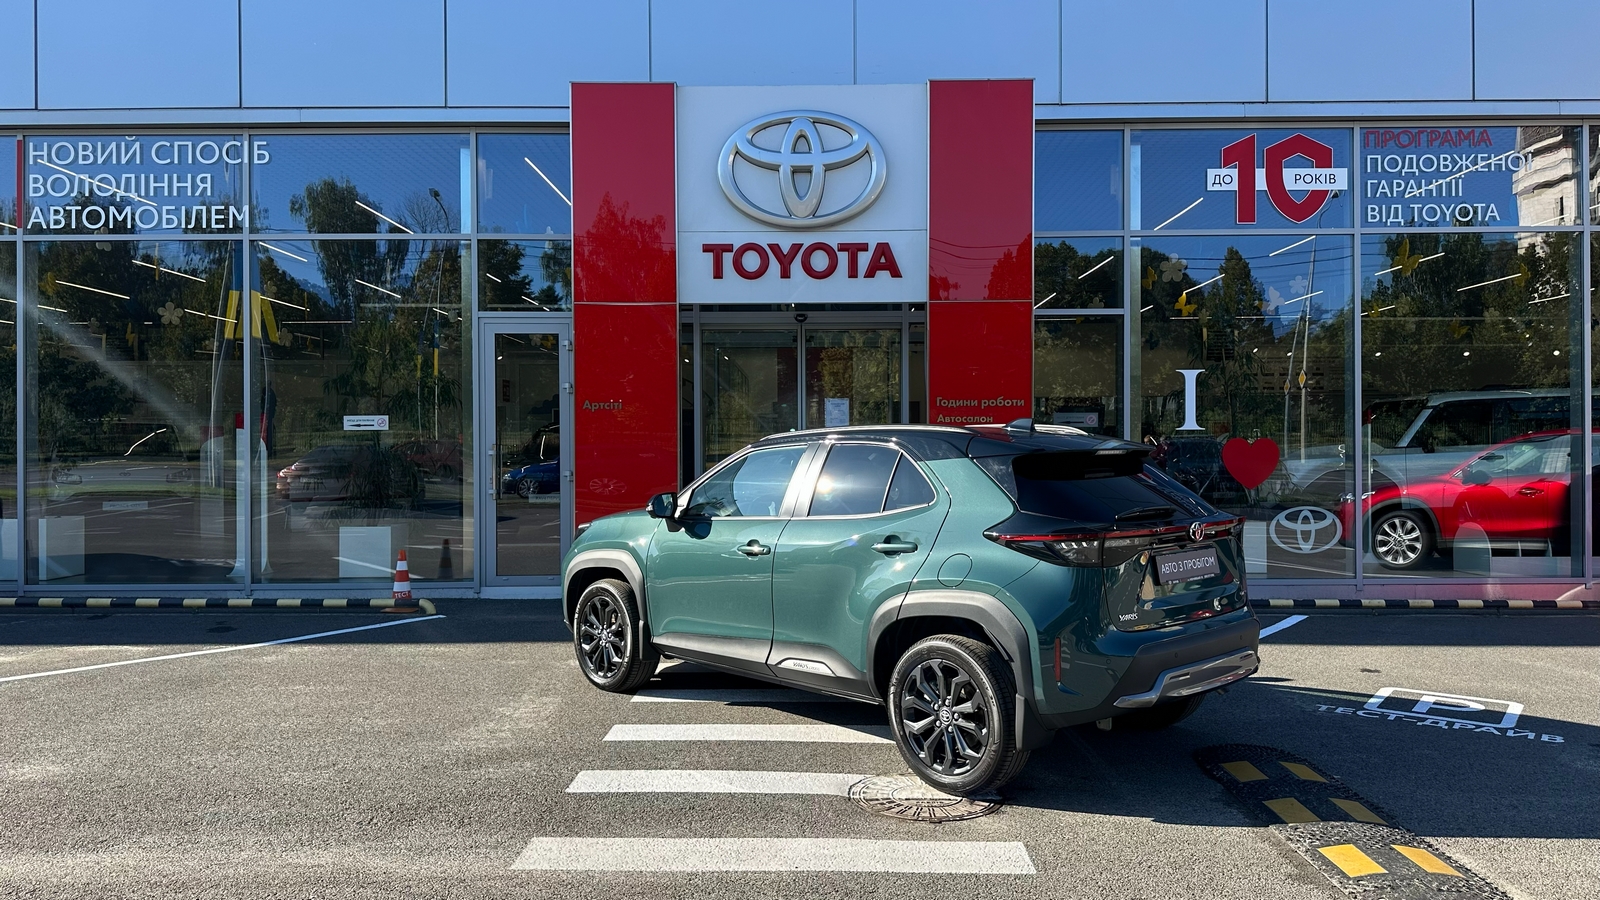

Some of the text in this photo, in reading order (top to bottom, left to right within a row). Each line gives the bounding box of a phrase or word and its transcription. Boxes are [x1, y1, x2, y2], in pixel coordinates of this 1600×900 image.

[1364, 129, 1493, 148] ПРОГРАМА
[29, 136, 270, 165] НОВИЙ СПОСІБ
[1366, 149, 1533, 176] ПОДОВЖЕНОЇ
[29, 173, 212, 202] ВОЛОДІННЯ
[1211, 132, 1337, 224] ДО 10 РОКІВ
[1367, 175, 1464, 198] ГАРАНТІЇ
[27, 205, 249, 229] АВТОМОБІЛЕМ
[1367, 203, 1500, 226] ВІД TOYOTA
[702, 242, 903, 280] TOYOTA
[582, 399, 622, 412] Артсіті
[936, 396, 1025, 409] Години роботи
[937, 413, 993, 423] Автосалон
[1161, 562, 1178, 574] АВТО
[1184, 556, 1216, 571] ПРОБІГОМ
[1411, 695, 1486, 713] P
[1316, 703, 1565, 744] ТЕСТ-ДРАЙВ
